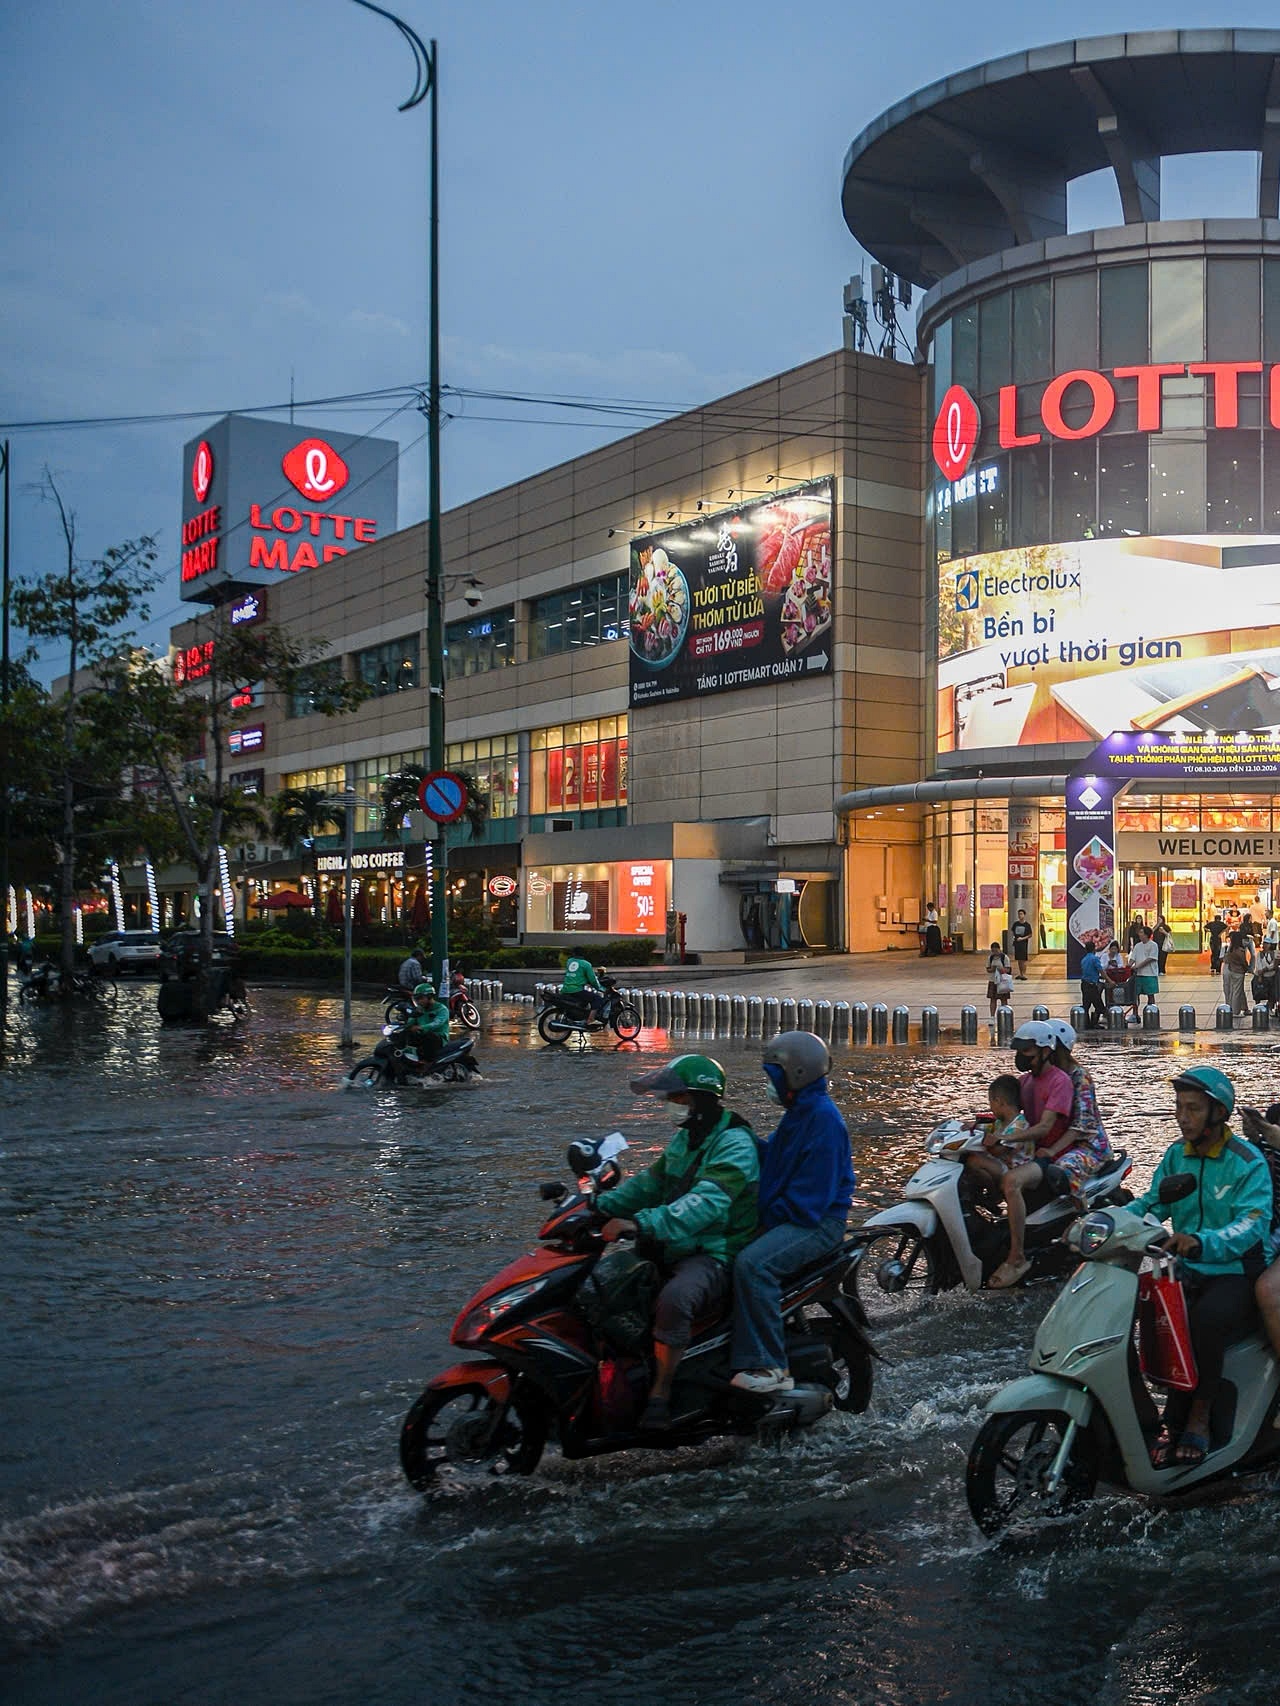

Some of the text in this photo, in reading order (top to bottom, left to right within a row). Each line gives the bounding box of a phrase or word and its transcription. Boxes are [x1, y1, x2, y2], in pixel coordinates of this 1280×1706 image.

[183, 505, 221, 546] LOTTE
[250, 504, 377, 542] LOTTE
[181, 537, 219, 582] MART
[693, 567, 764, 607] TƯƠI TỪ BIỂN
[984, 569, 1080, 597] Electrolux
[693, 595, 765, 630] THƠM TỪ LỬA
[984, 608, 1056, 640] Bền bỉ
[730, 639, 743, 648] VND
[1000, 637, 1182, 671] vượt thời gian
[719, 674, 722, 685] 1
[724, 665, 771, 685] LOTTEMART
[772, 659, 797, 677] QUẬN
[798, 659, 803, 671] 7
[1109, 755, 1123, 764] TẠI
[1124, 754, 1134, 764] HỆ
[1242, 754, 1267, 762] LOTTE
[1151, 745, 1180, 753] KHÔNG
[369, 851, 405, 868] COFFEE
[1158, 839, 1264, 855] WELCOME
